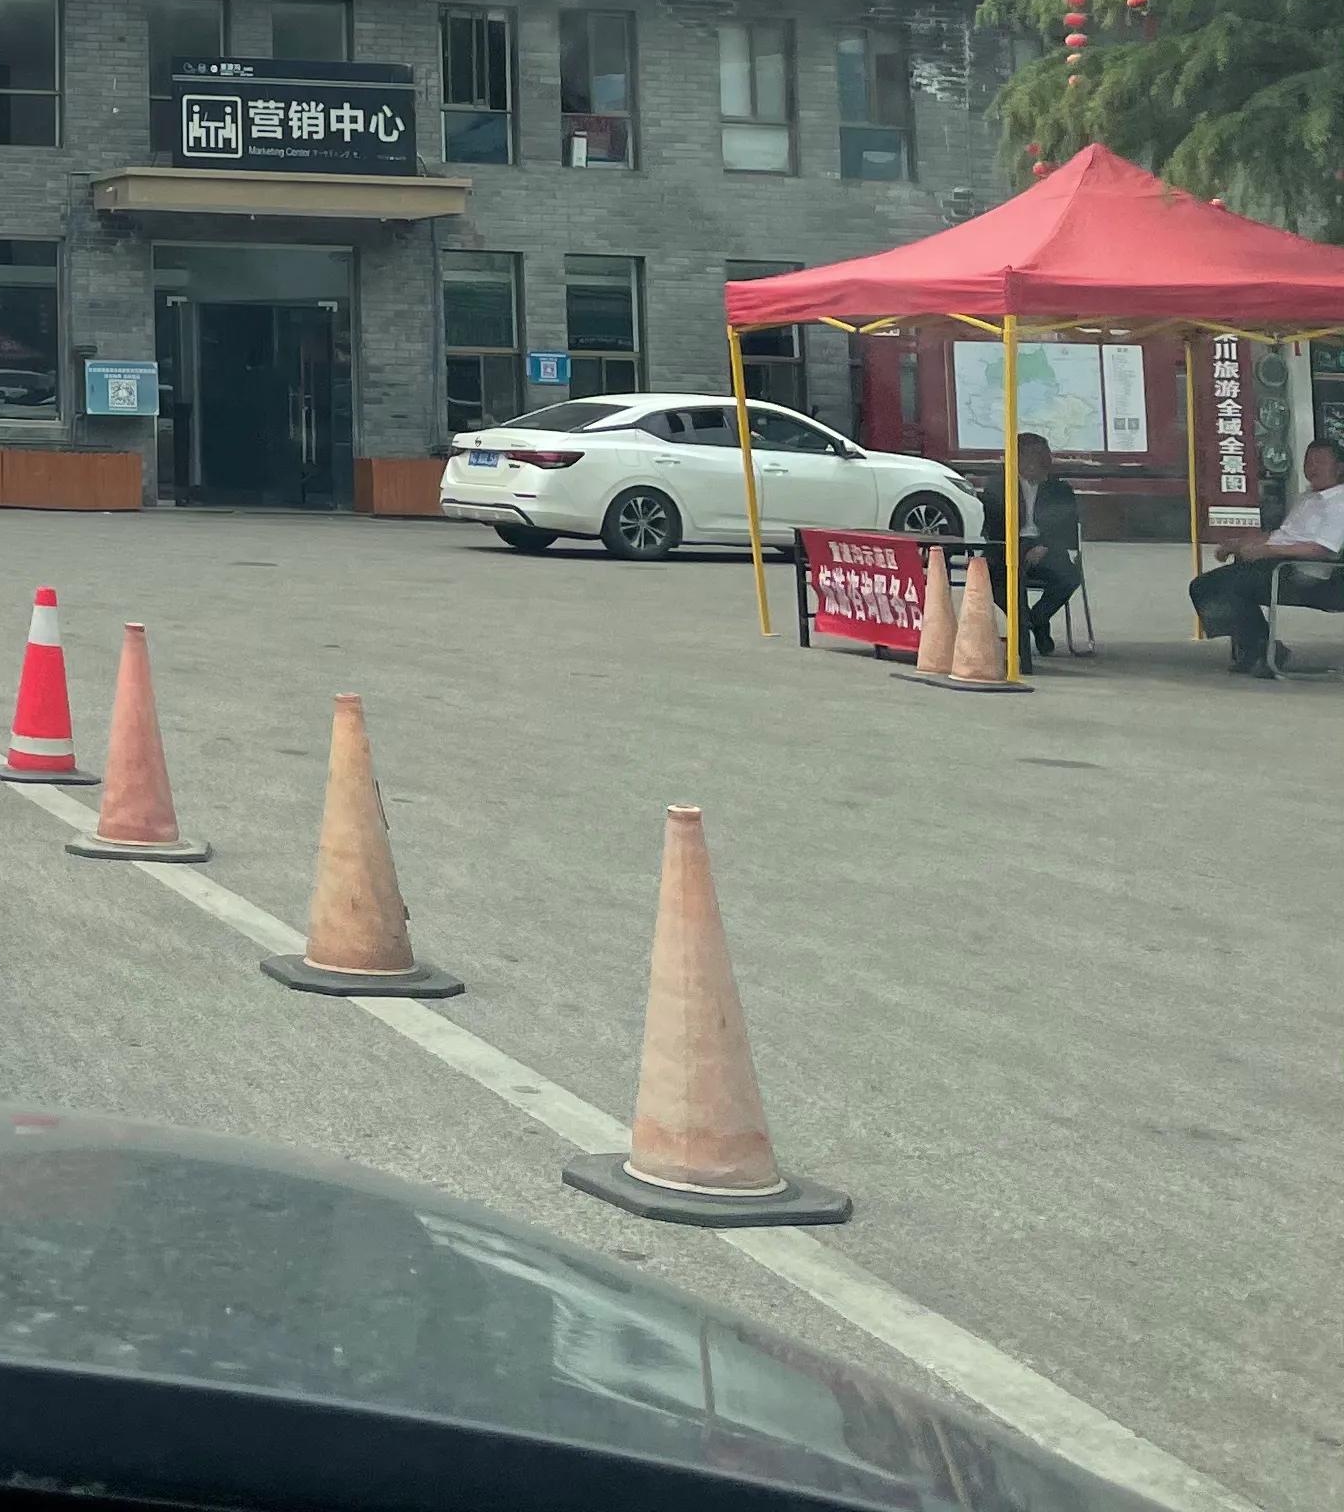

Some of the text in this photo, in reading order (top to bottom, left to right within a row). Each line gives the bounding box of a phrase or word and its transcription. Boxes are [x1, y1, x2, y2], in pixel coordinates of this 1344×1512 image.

[247, 99, 406, 143] 营销中心
[248, 145, 285, 158] Marketing
